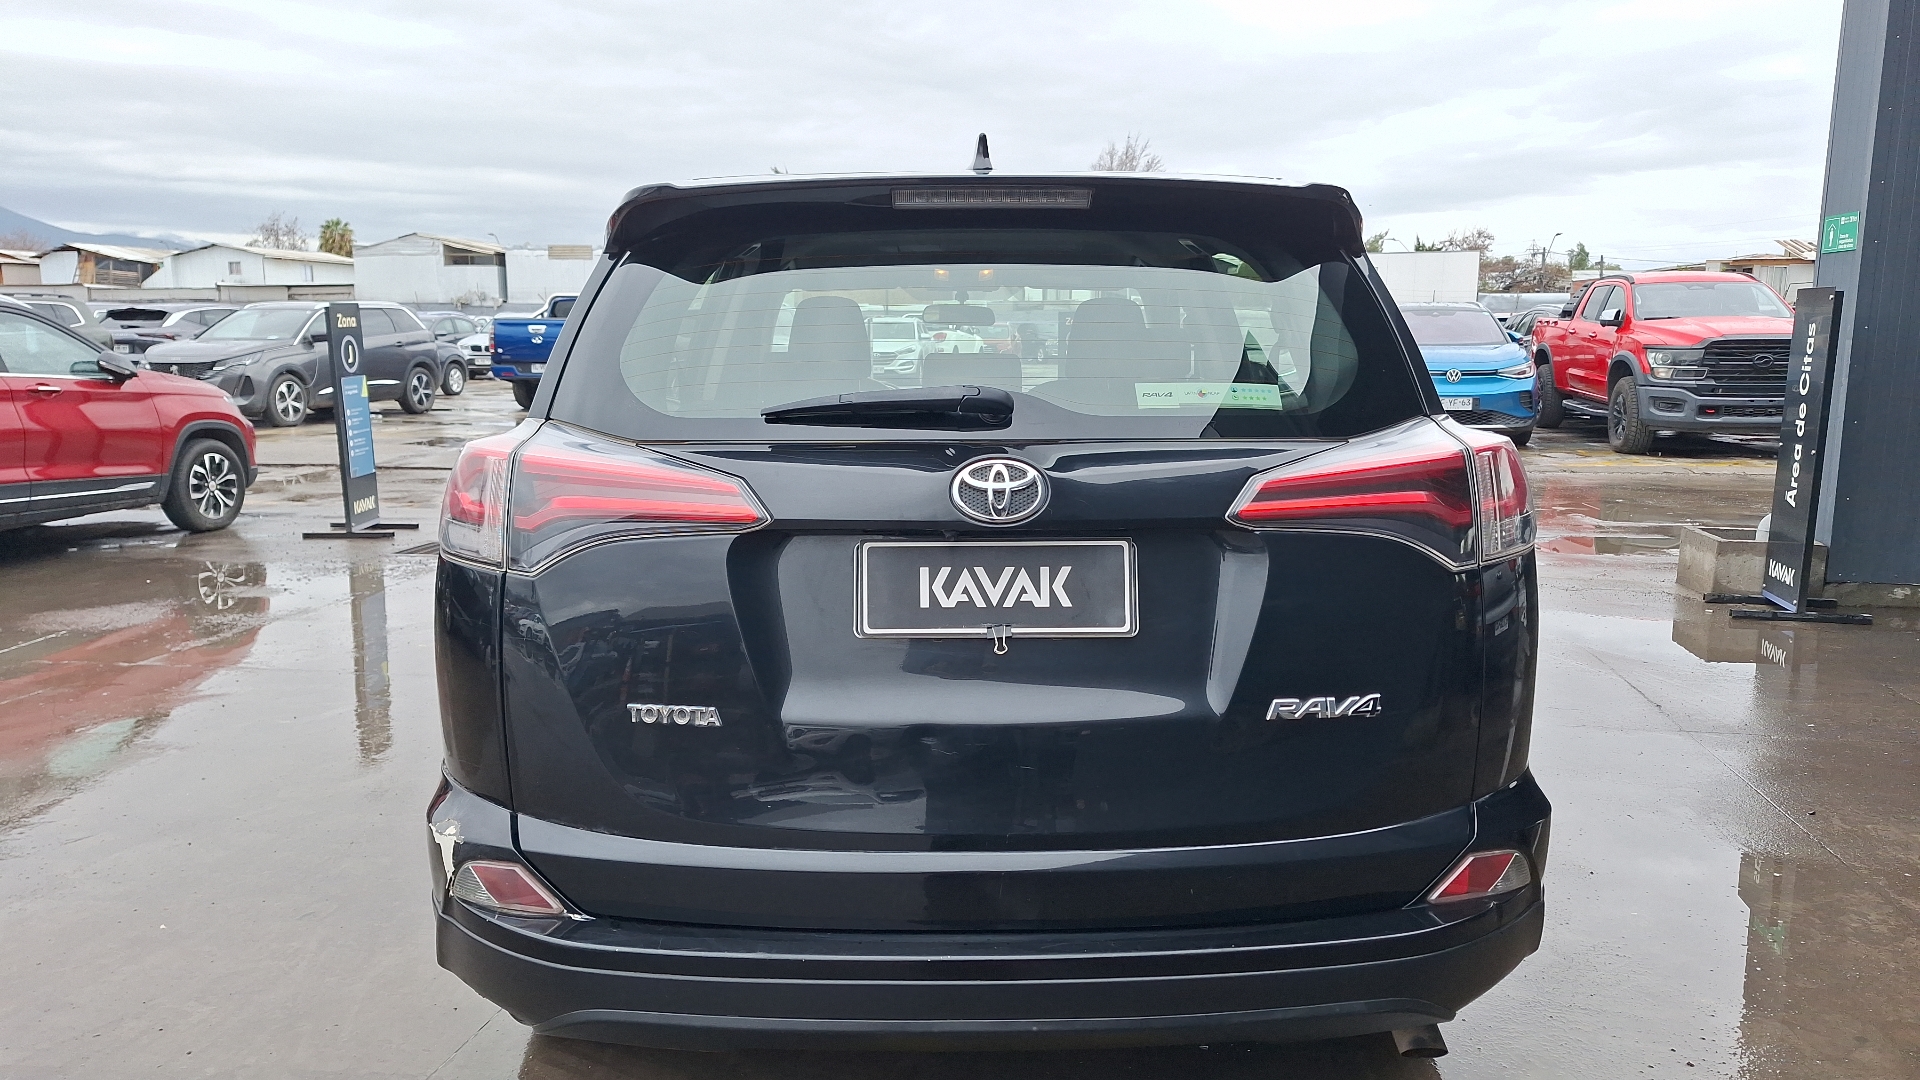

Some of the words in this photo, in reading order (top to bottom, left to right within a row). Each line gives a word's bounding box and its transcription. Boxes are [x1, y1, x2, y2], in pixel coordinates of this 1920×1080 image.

[336, 312, 357, 328] Zona
[1799, 322, 1817, 396] Citas
[1794, 402, 1807, 437] de
[1784, 444, 1803, 508] Área
[353, 494, 376, 515] KAVAK
[919, 566, 1073, 608] KAVAK
[1768, 558, 1796, 587] KAVAK
[626, 703, 723, 726] TOYOTA
[1265, 693, 1382, 720] RAV4
